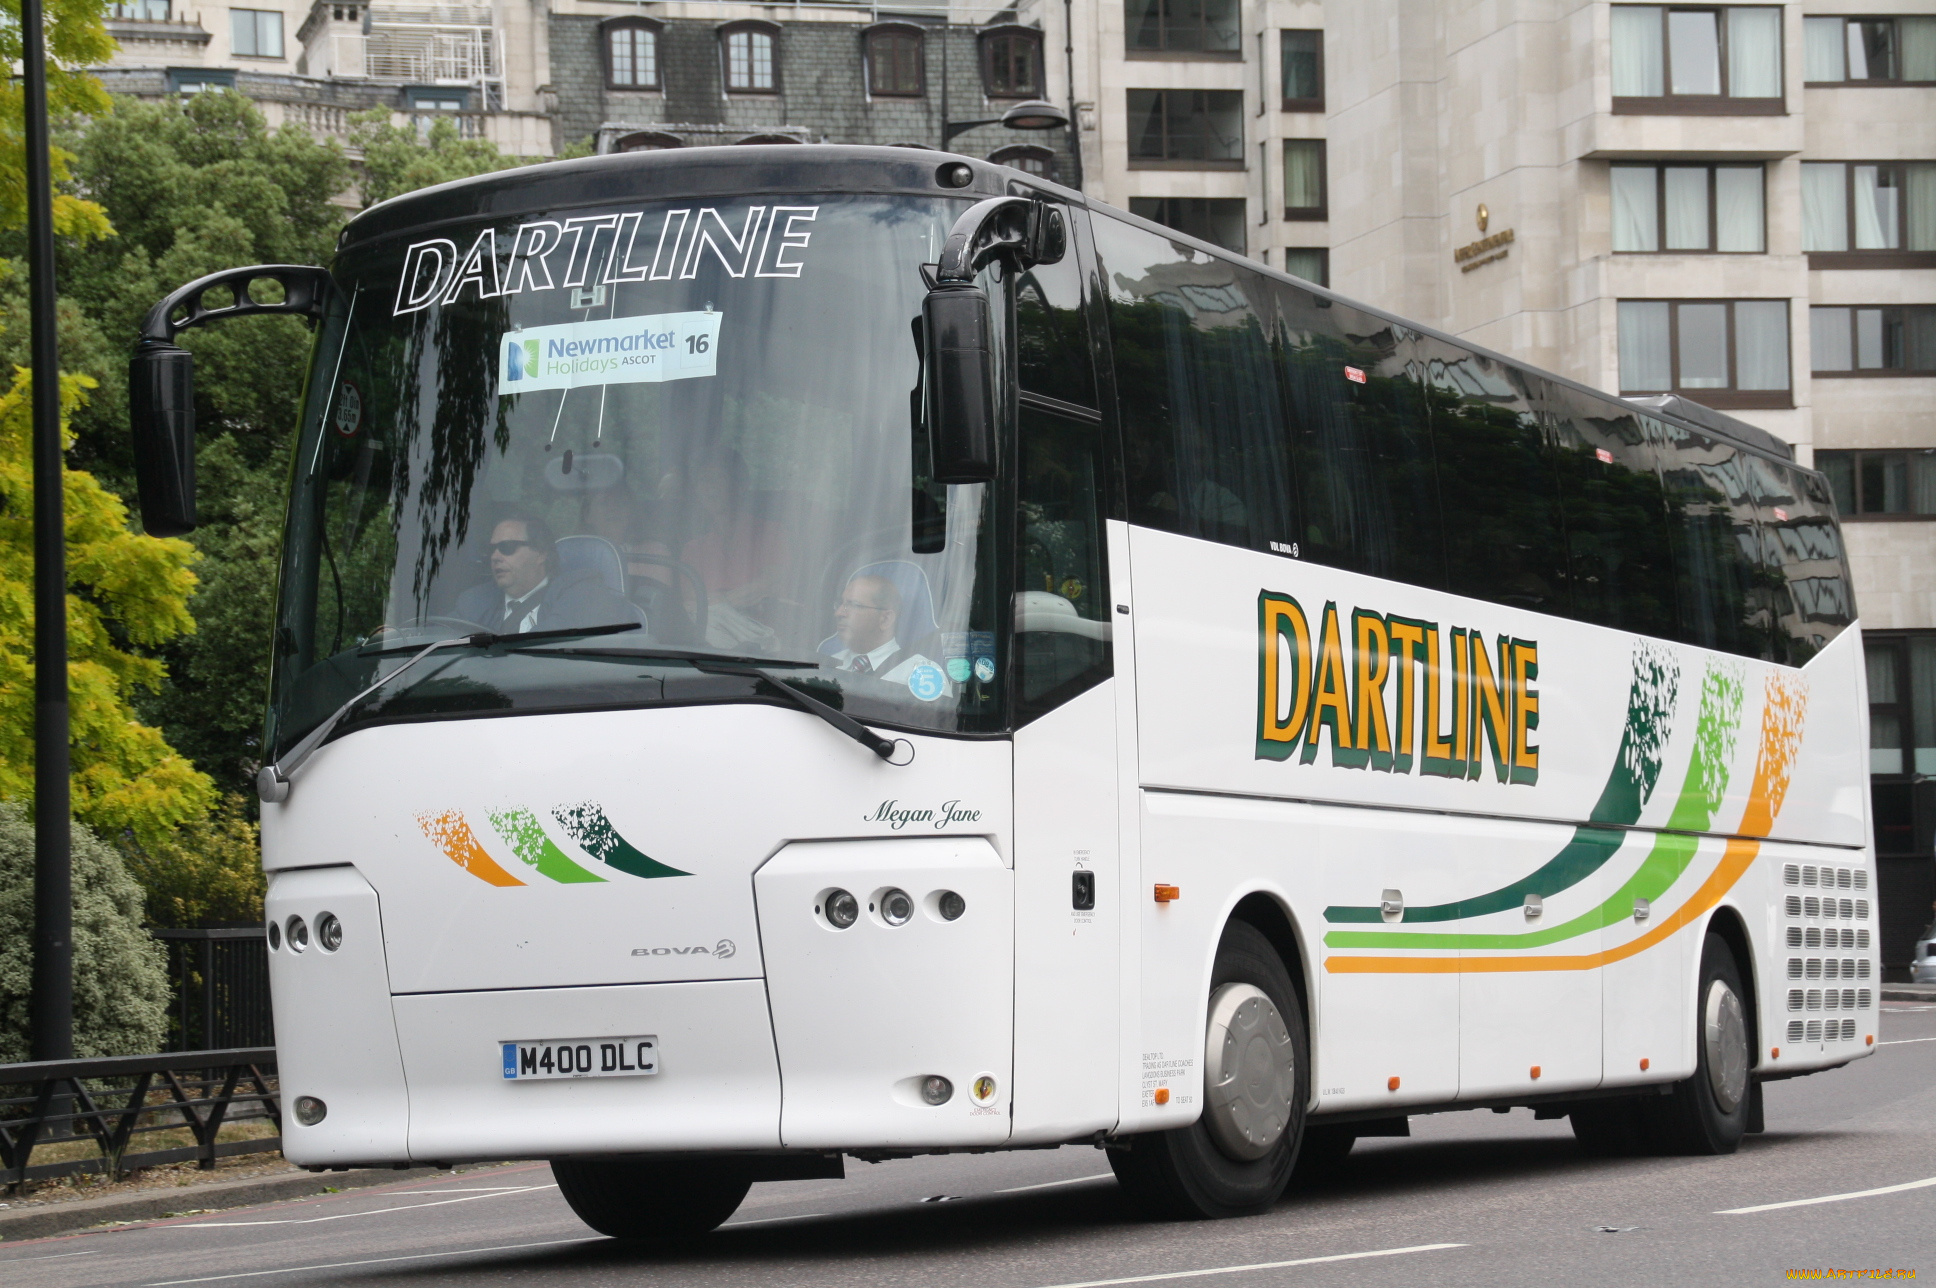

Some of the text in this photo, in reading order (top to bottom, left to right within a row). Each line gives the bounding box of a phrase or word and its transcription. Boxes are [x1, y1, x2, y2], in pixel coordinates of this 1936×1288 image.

[393, 206, 819, 316] DARTLINE
[548, 329, 709, 358] Newmarket 16
[547, 355, 656, 375] Holidays ASCOT
[919, 674, 936, 696] 5
[1255, 588, 1539, 787] DARTLINE
[863, 799, 983, 830] Megan Jane
[630, 946, 711, 958] BOVA
[504, 1067, 516, 1075] GB
[520, 1042, 654, 1075] M400 DLC
